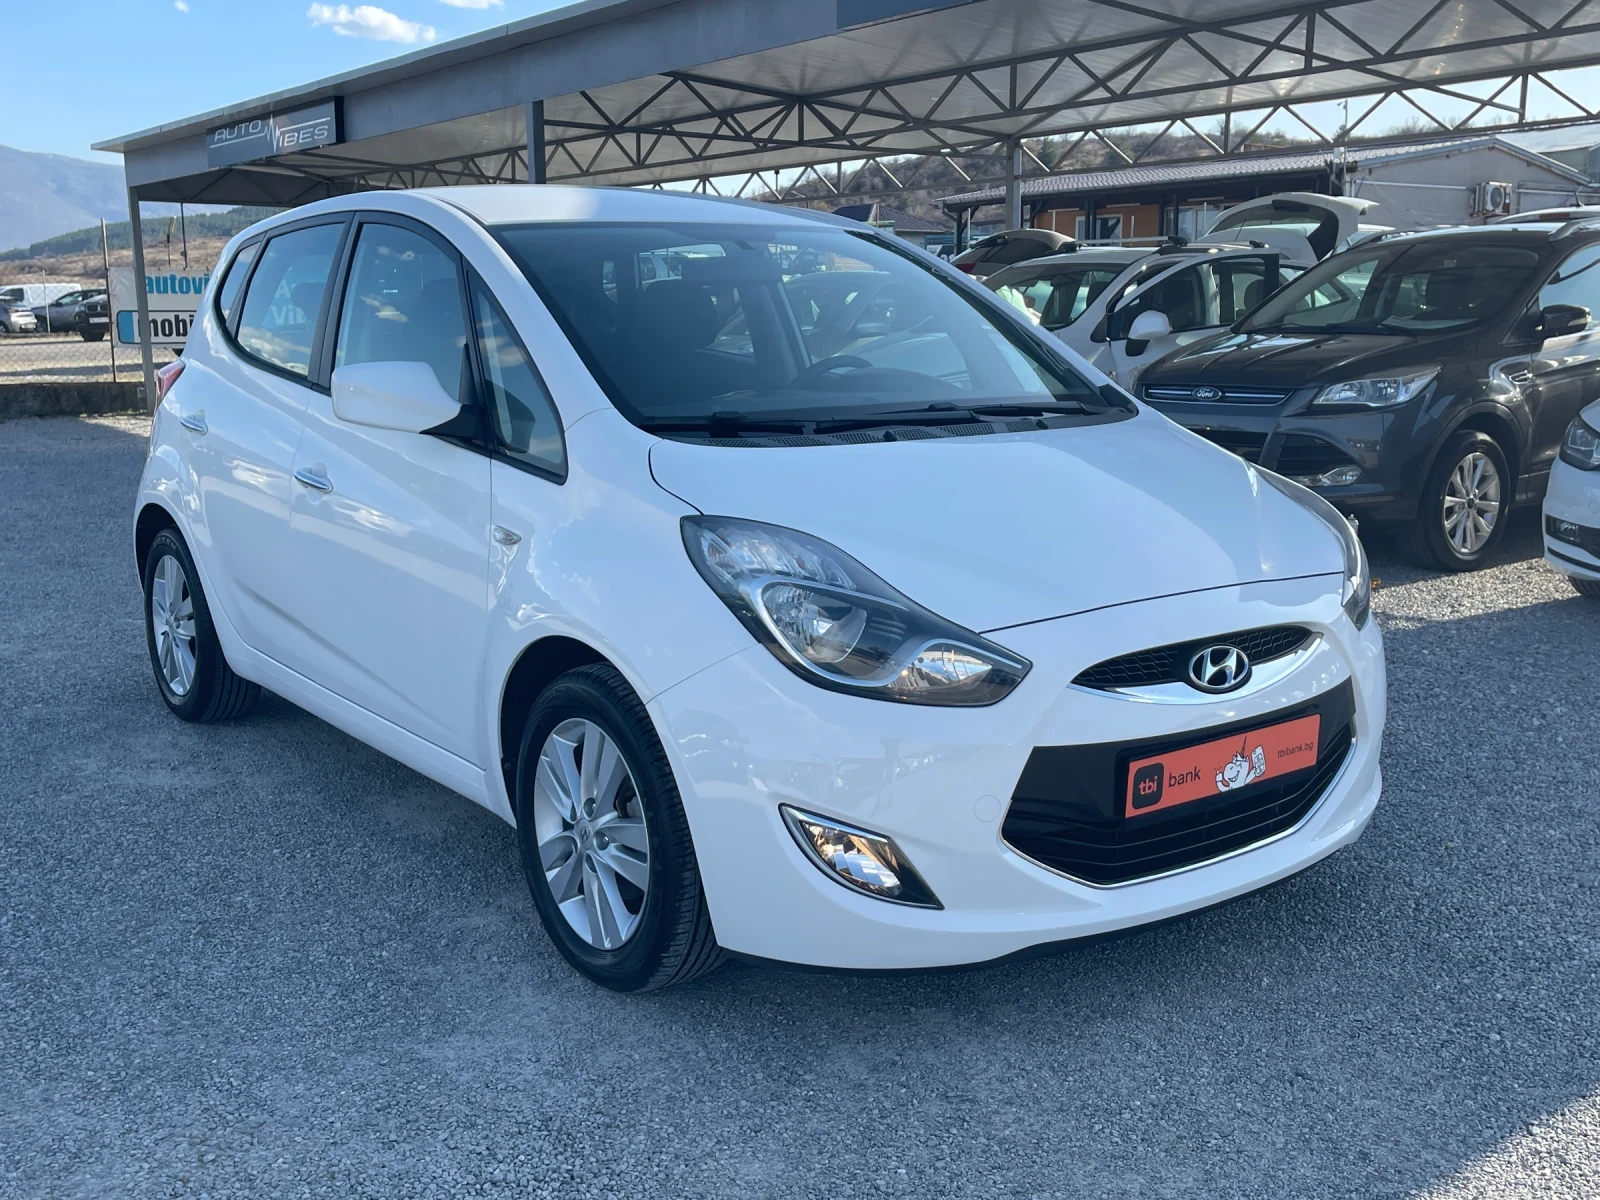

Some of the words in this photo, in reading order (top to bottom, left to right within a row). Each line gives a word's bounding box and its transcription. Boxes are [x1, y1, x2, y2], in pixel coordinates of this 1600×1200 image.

[214, 119, 262, 142] AUTO
[1277, 742, 1314, 758] tbibank.bg
[1138, 775, 1158, 795] tbi
[1168, 765, 1201, 788] bank
